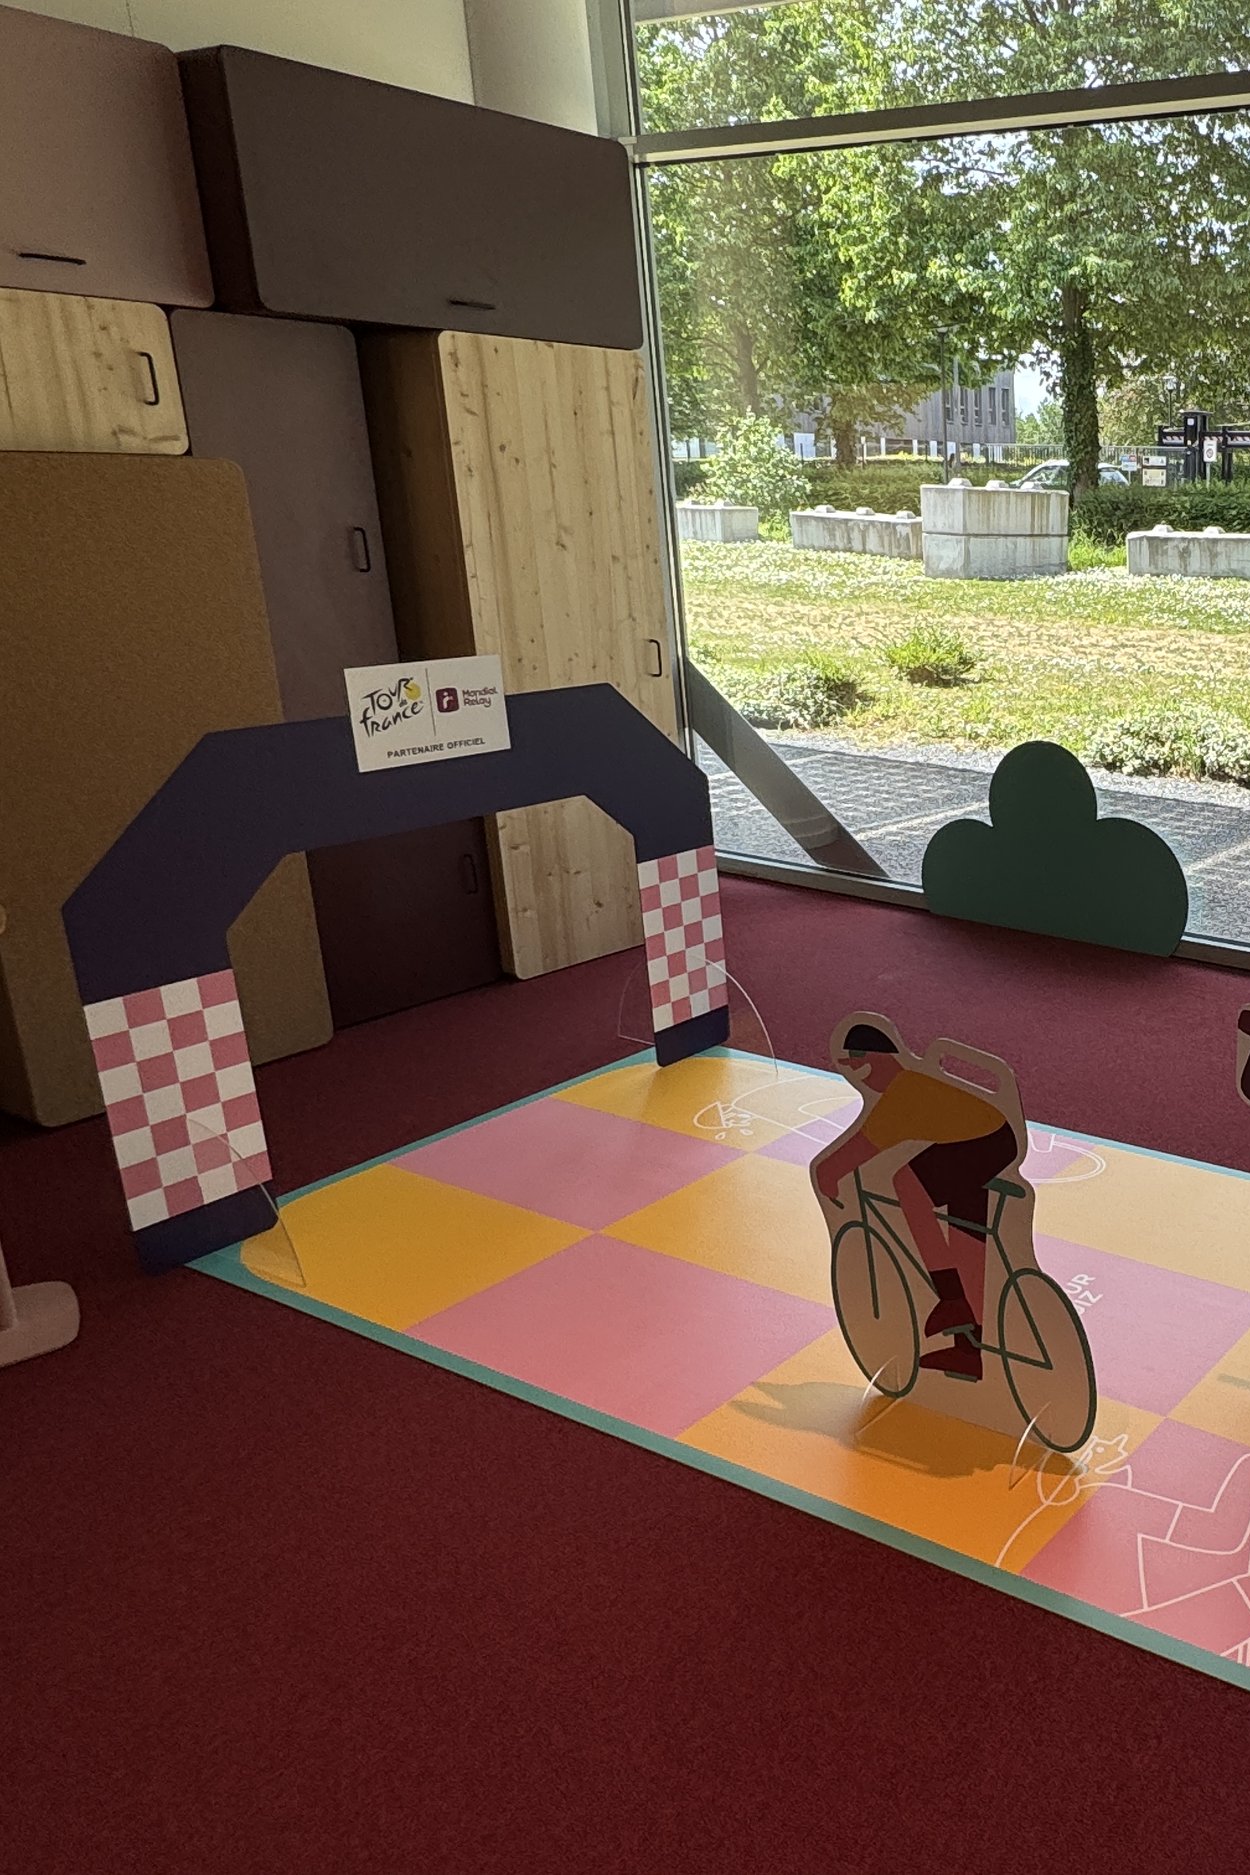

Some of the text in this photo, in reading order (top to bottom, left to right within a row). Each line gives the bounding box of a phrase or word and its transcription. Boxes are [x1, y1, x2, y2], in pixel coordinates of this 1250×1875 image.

[462, 686, 498, 698] Mondial
[463, 697, 492, 708] Relay
[387, 737, 486, 759] PARTENAIRE OFFICIEL
